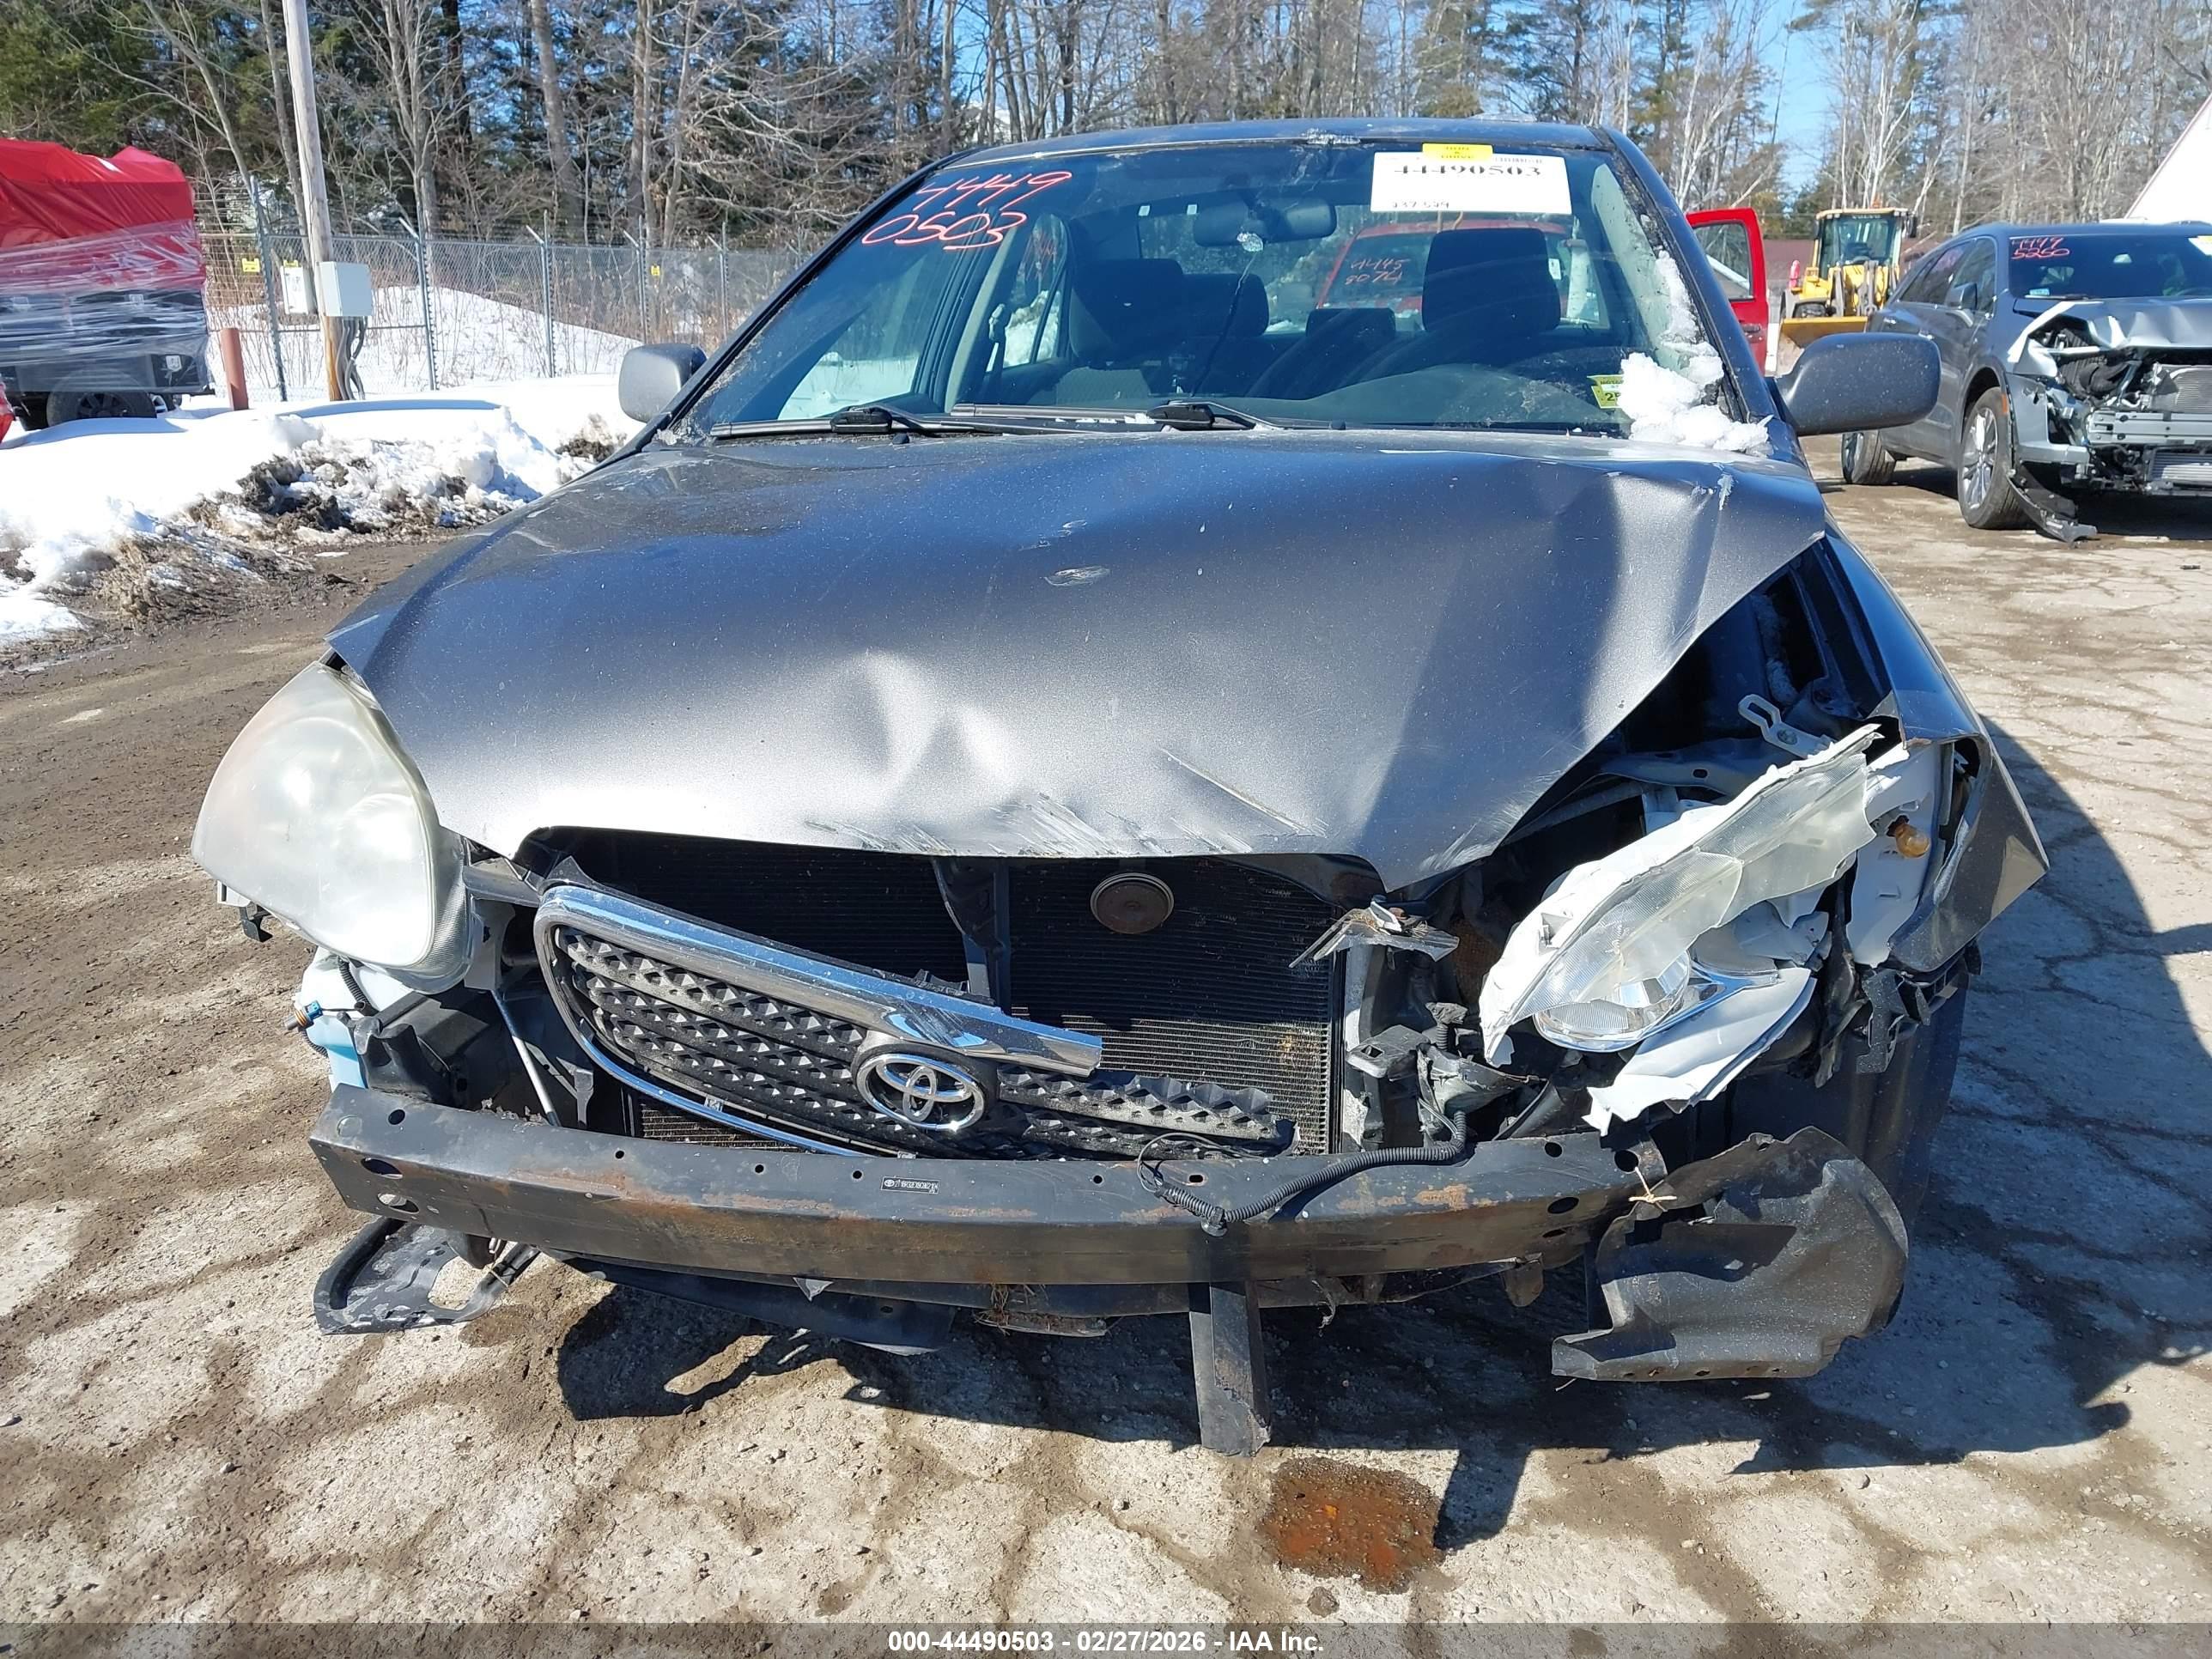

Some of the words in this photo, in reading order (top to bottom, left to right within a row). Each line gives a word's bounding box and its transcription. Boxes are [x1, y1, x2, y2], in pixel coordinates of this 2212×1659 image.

[912, 171, 1073, 212] 4449
[861, 210, 1028, 251] 0503
[2010, 247, 2070, 260] 5250
